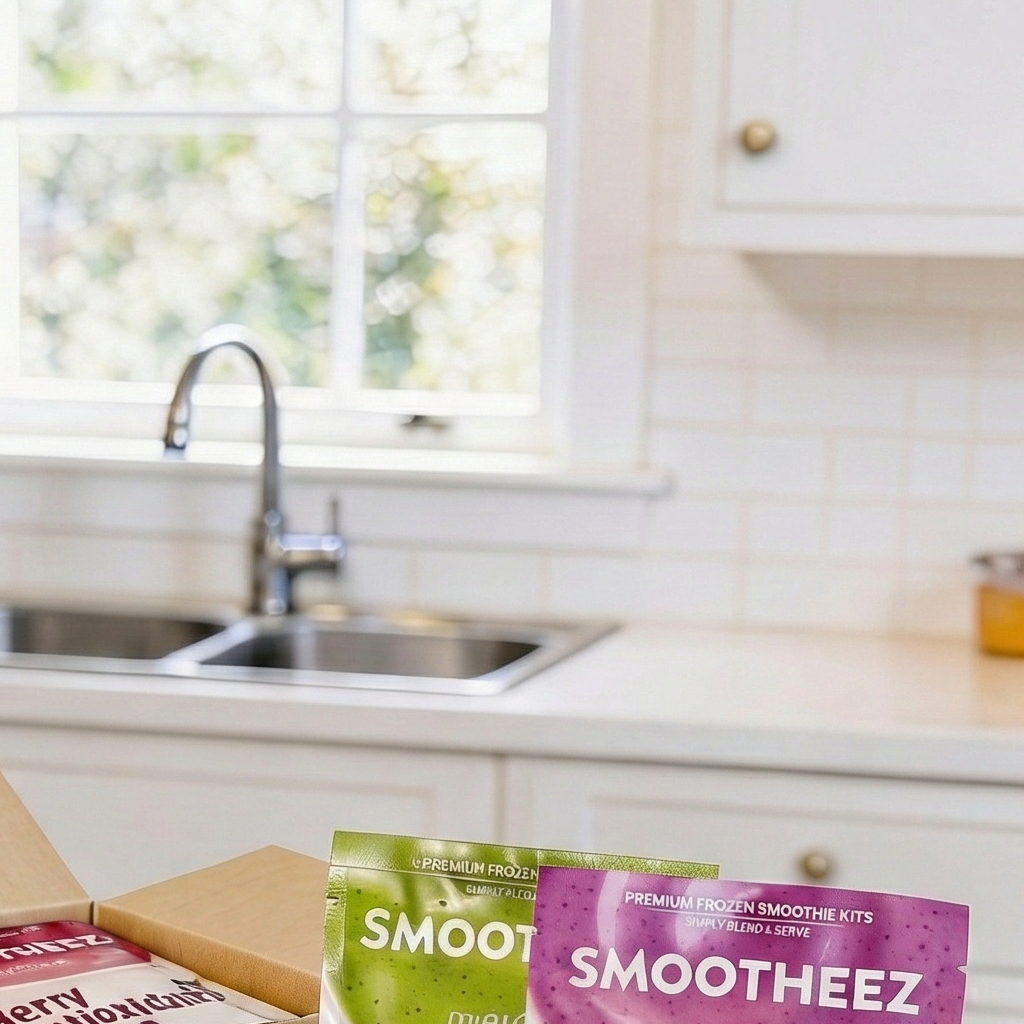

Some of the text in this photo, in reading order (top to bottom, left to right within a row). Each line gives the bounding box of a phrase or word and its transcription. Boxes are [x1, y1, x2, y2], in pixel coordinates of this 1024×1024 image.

[625, 891, 874, 924] PREMIUM FROZEN SMOOTHIE KITS
[726, 920, 763, 934] BLEND
[774, 924, 811, 938] SERVE
[568, 946, 924, 1016] SMOOTHEEZ
